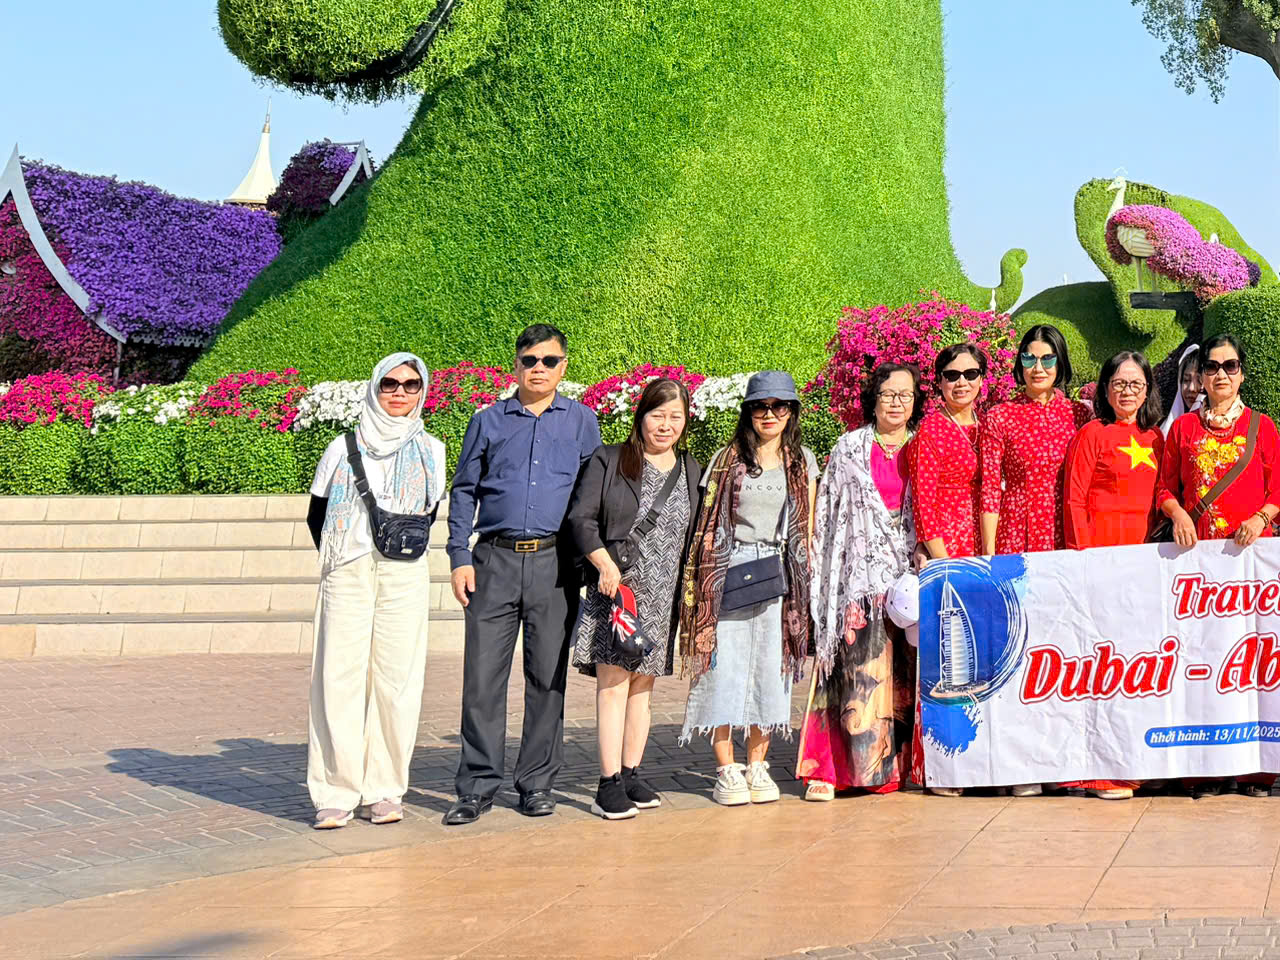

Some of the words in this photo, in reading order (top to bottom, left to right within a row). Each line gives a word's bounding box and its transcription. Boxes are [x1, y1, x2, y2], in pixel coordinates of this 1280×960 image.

[1020, 637, 1179, 703] Dubai
[1187, 666, 1210, 677] -
[1177, 729, 1210, 742] hành:
